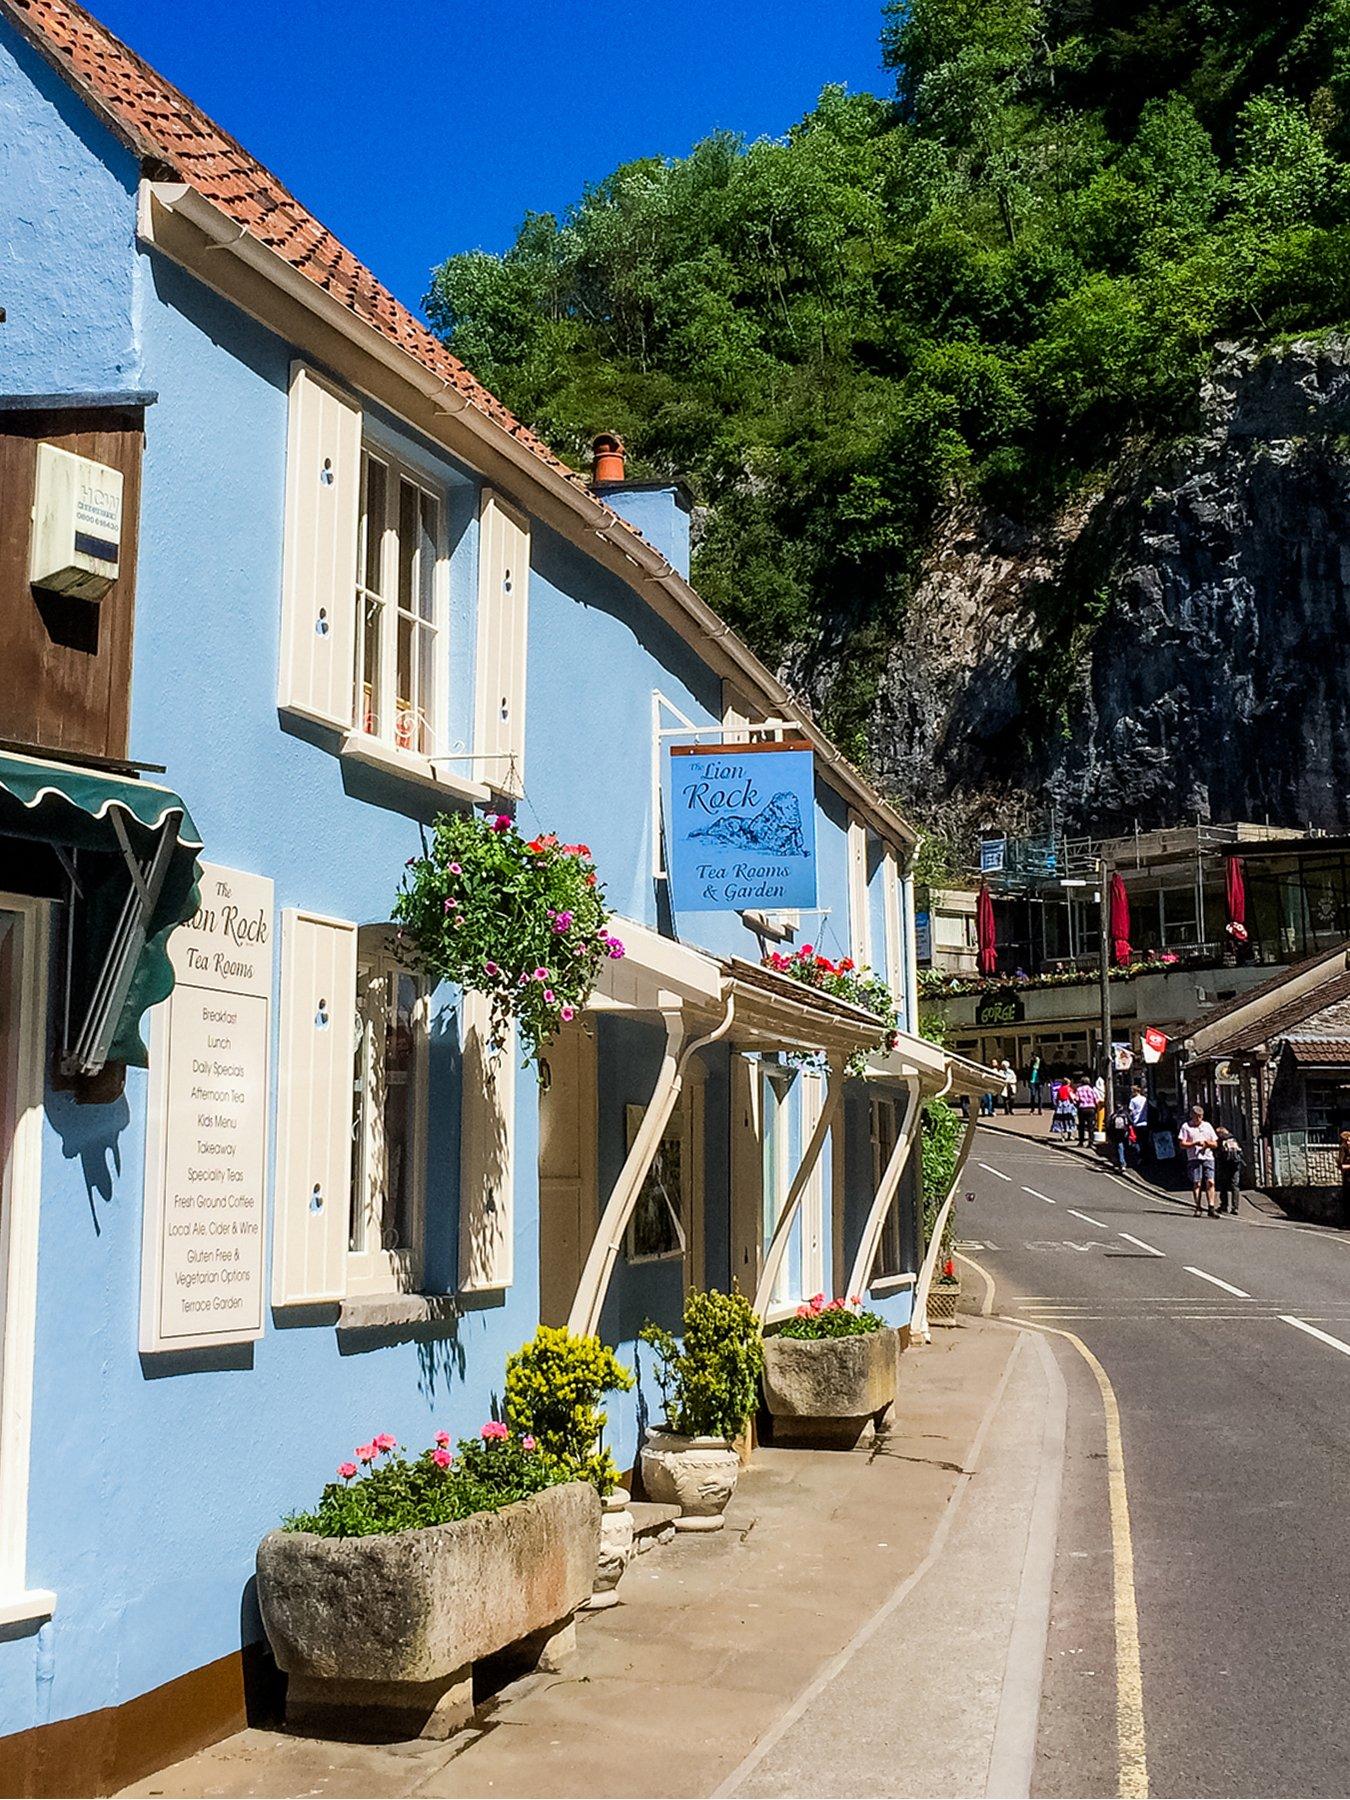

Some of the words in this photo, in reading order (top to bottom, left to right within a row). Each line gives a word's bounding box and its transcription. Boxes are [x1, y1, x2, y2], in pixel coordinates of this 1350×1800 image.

[702, 761, 747, 780] Lion
[683, 778, 763, 815] Rock
[696, 864, 726, 880] Tea
[732, 863, 790, 882] Rooms
[215, 881, 232, 899] The
[703, 884, 719, 902] &
[724, 881, 785, 902] Garden
[181, 907, 217, 933] on
[221, 905, 269, 947] Rock
[187, 947, 209, 970] Tea
[213, 953, 253, 979] Rooms
[202, 1007, 238, 1024] Breakfast
[207, 1034, 232, 1050] Lunch
[192, 1059, 213, 1077] Daily
[213, 1061, 245, 1078] Specials
[190, 1086, 230, 1102] Afternoon
[231, 1089, 245, 1104] Tea
[197, 1113, 214, 1128] Kids
[215, 1114, 238, 1129] Menu
[197, 1140, 237, 1157] Takeaway
[226, 1167, 244, 1183] Teas
[174, 1194, 195, 1208] Fresh
[196, 1194, 227, 1209] Ground
[227, 1194, 255, 1209] Coffee
[168, 1222, 192, 1237] Local
[208, 1220, 231, 1236] Cider
[231, 1220, 238, 1235] &
[240, 1220, 259, 1235] Wine
[187, 1249, 214, 1263] Gluten
[215, 1248, 233, 1262] Free
[233, 1247, 240, 1262] &
[175, 1271, 219, 1289] Vegetarian
[220, 1268, 251, 1285] Options
[181, 1298, 212, 1313] Terrace
[212, 1296, 243, 1311] Garden
